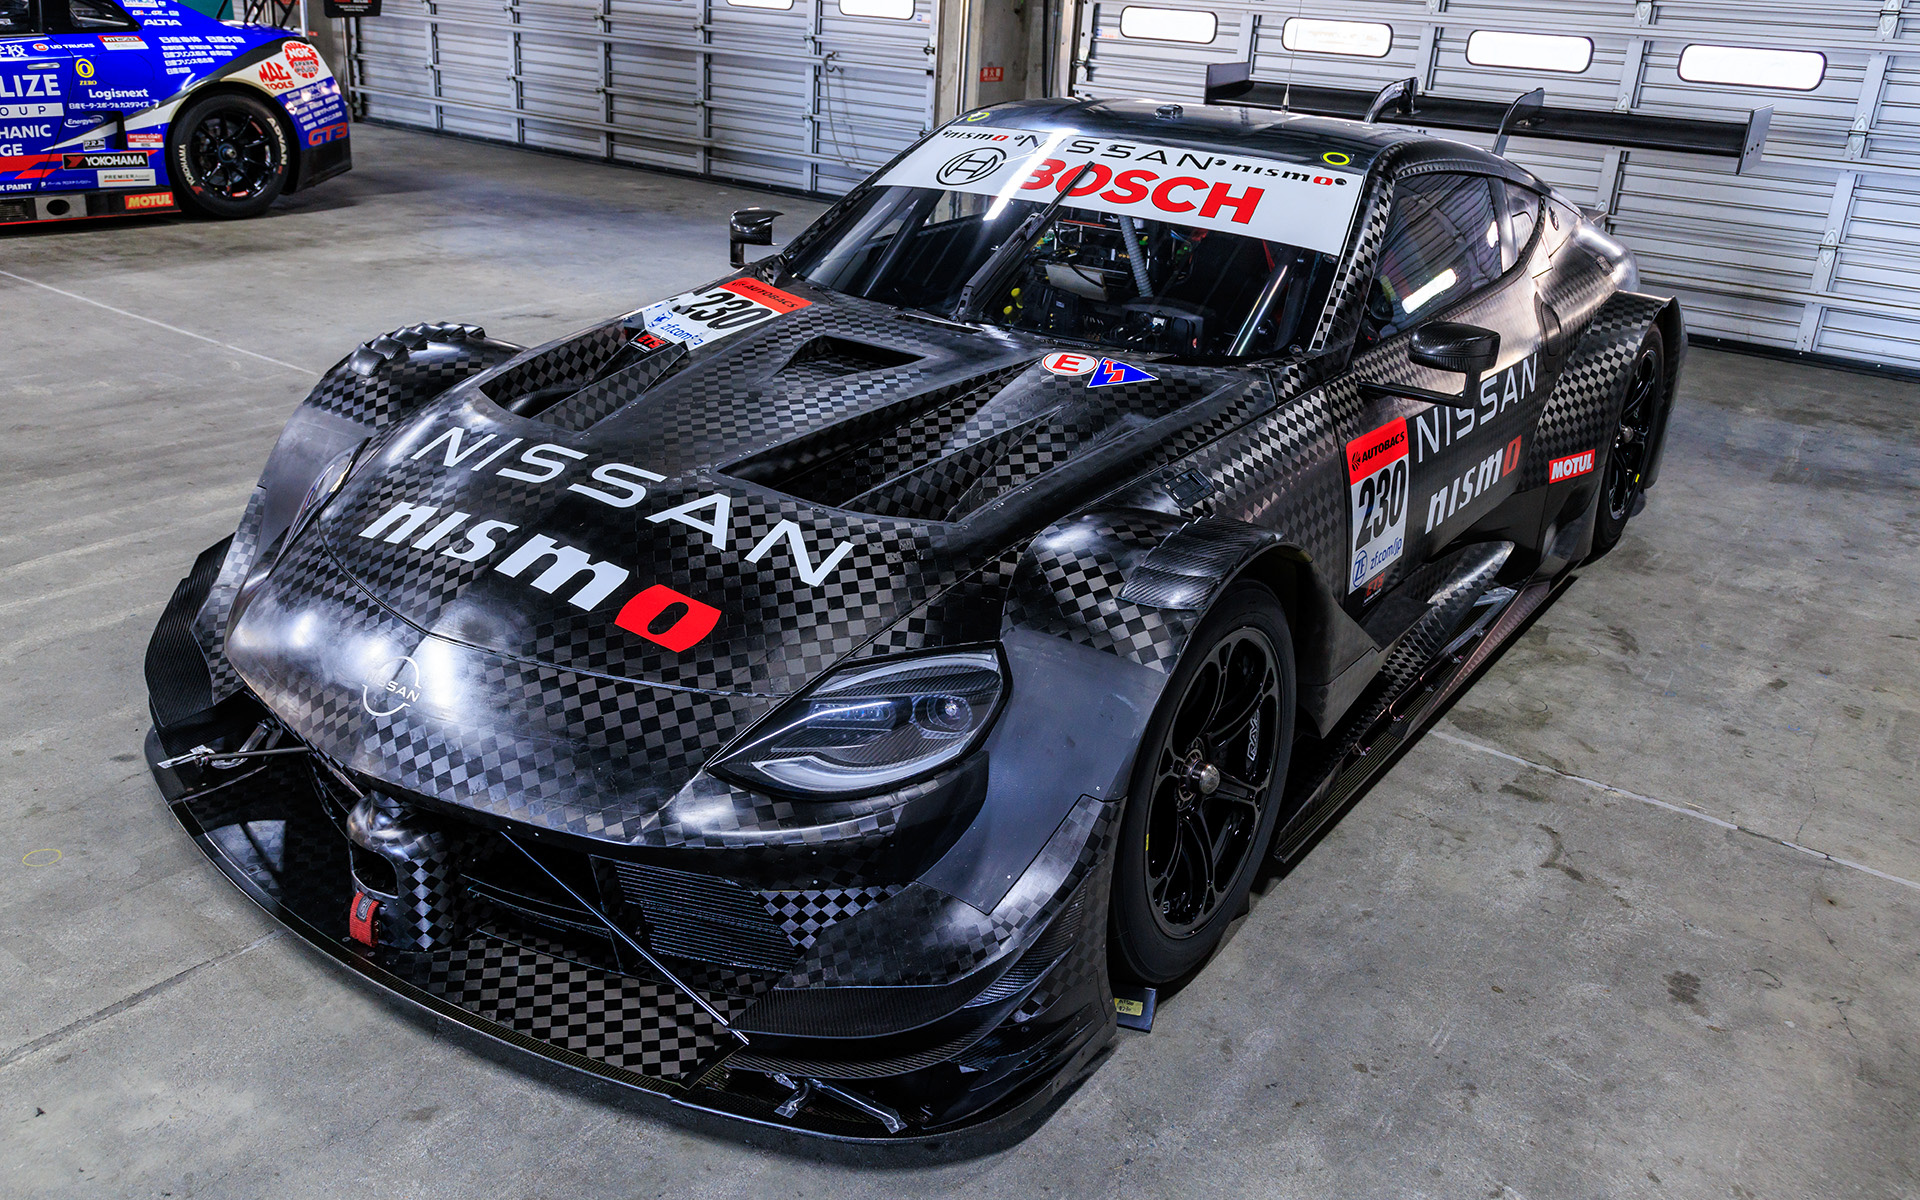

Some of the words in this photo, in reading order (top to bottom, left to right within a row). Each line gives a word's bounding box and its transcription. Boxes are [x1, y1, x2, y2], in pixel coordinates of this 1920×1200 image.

[287, 47, 313, 59] NGK
[259, 62, 292, 82] MAC
[0, 74, 61, 98] LIZE
[88, 88, 149, 100] Logisnext
[264, 80, 295, 90] TOOLS
[0, 105, 47, 117] OUP
[266, 117, 287, 165] ADVAN
[308, 122, 348, 146] GT3
[944, 130, 1009, 141] nismo
[0, 144, 24, 156] GE
[85, 155, 146, 166] YOKOHAMA
[1017, 134, 1215, 170] NSSAN
[178, 144, 196, 186] YOKOHAMA
[1232, 162, 1333, 186] nismo
[6, 183, 33, 191] PAINT
[1021, 158, 1265, 224] BOSCH
[128, 195, 171, 208] MOTUL
[744, 285, 798, 308] AUTOBACS
[672, 292, 773, 330] 230
[637, 334, 666, 349] ETS
[1052, 354, 1087, 372] E
[1416, 352, 1538, 463] NISSAN
[1362, 431, 1405, 463] AUTOBACS
[1551, 453, 1592, 480] MOTUL
[1425, 434, 1522, 535] nismo
[411, 426, 855, 587] NISSAN
[1355, 459, 1406, 551] 230
[1370, 537, 1402, 570] zf.com/jp
[358, 500, 722, 653] nismo
[1366, 572, 1385, 597] ETS
[1247, 712, 1259, 761] RAY
